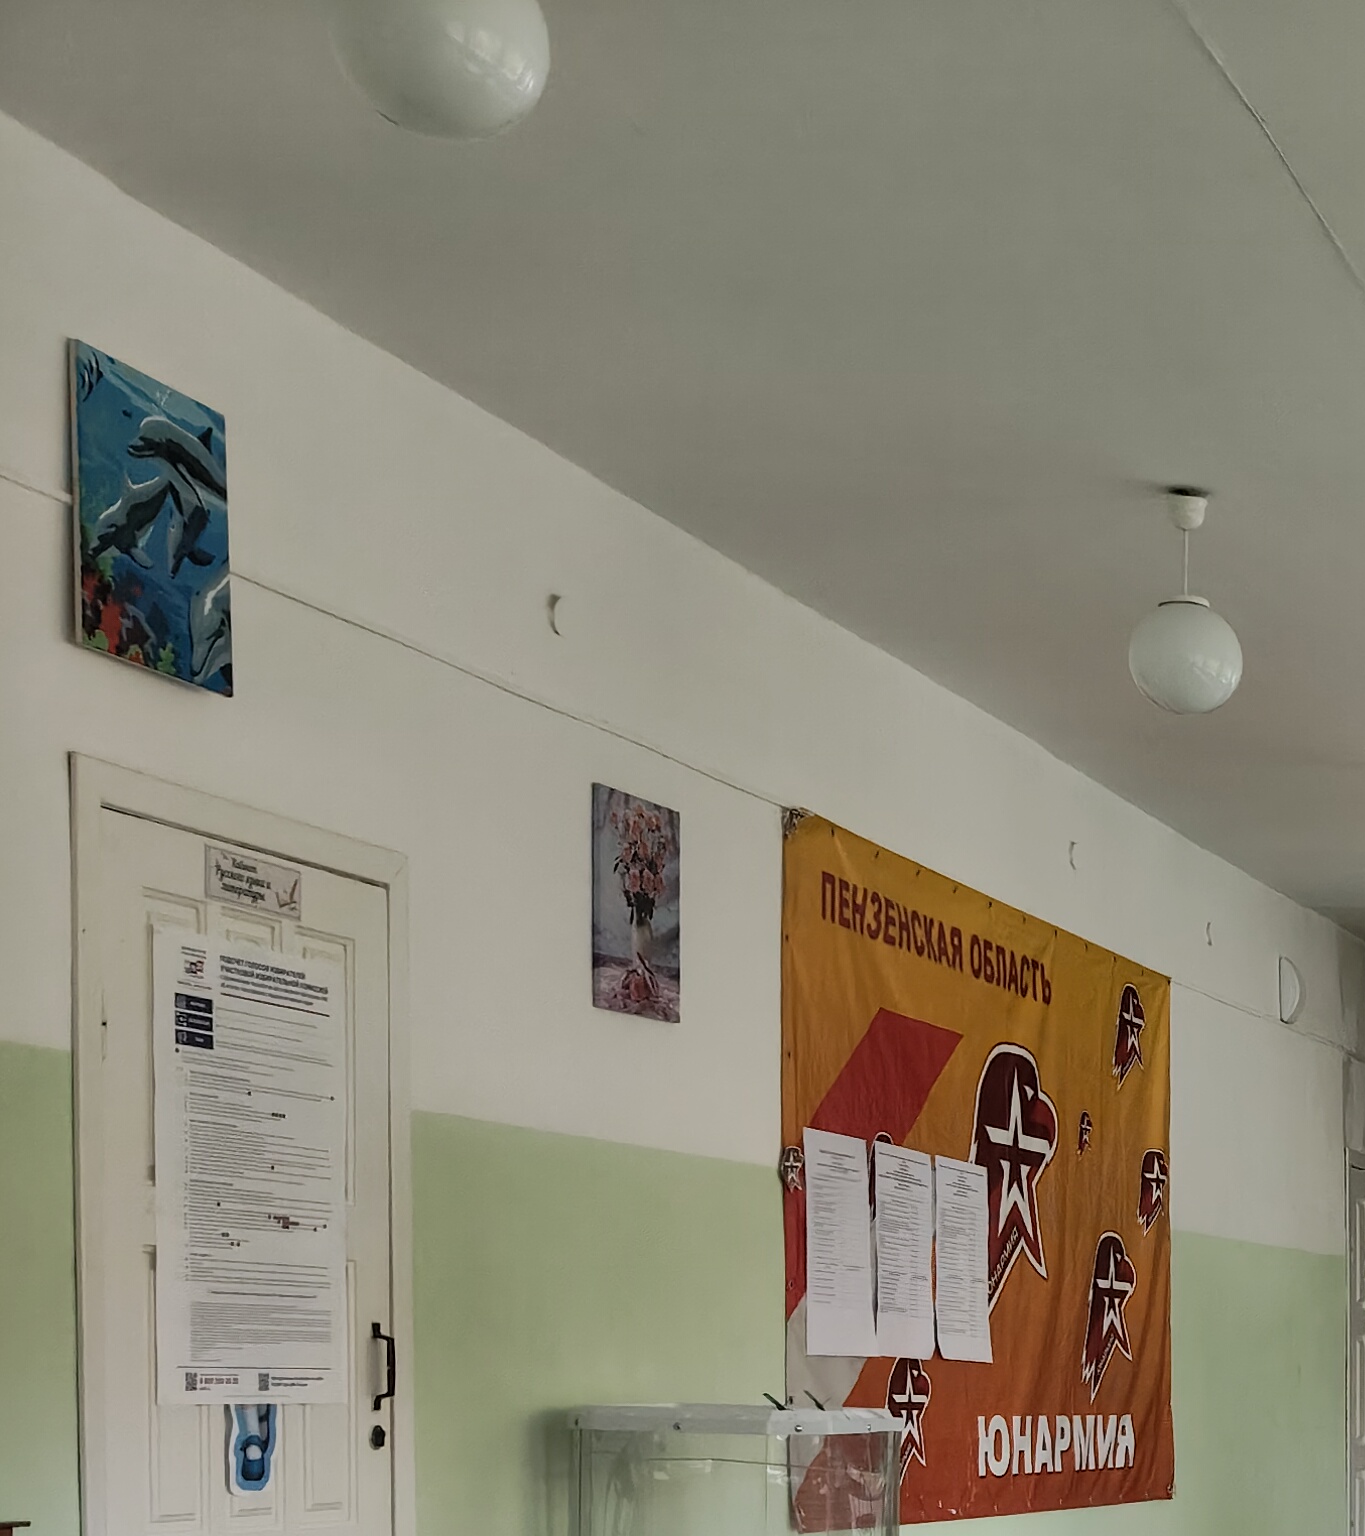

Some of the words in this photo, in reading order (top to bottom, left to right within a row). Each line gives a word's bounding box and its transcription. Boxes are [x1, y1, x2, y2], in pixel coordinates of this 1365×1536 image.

[822, 871, 963, 973] ПЕНЗЕНСКАЯ
[970, 934, 1052, 1006] ОБЛАСТЬ
[977, 1414, 1136, 1478] ЮНАРМИЯ
